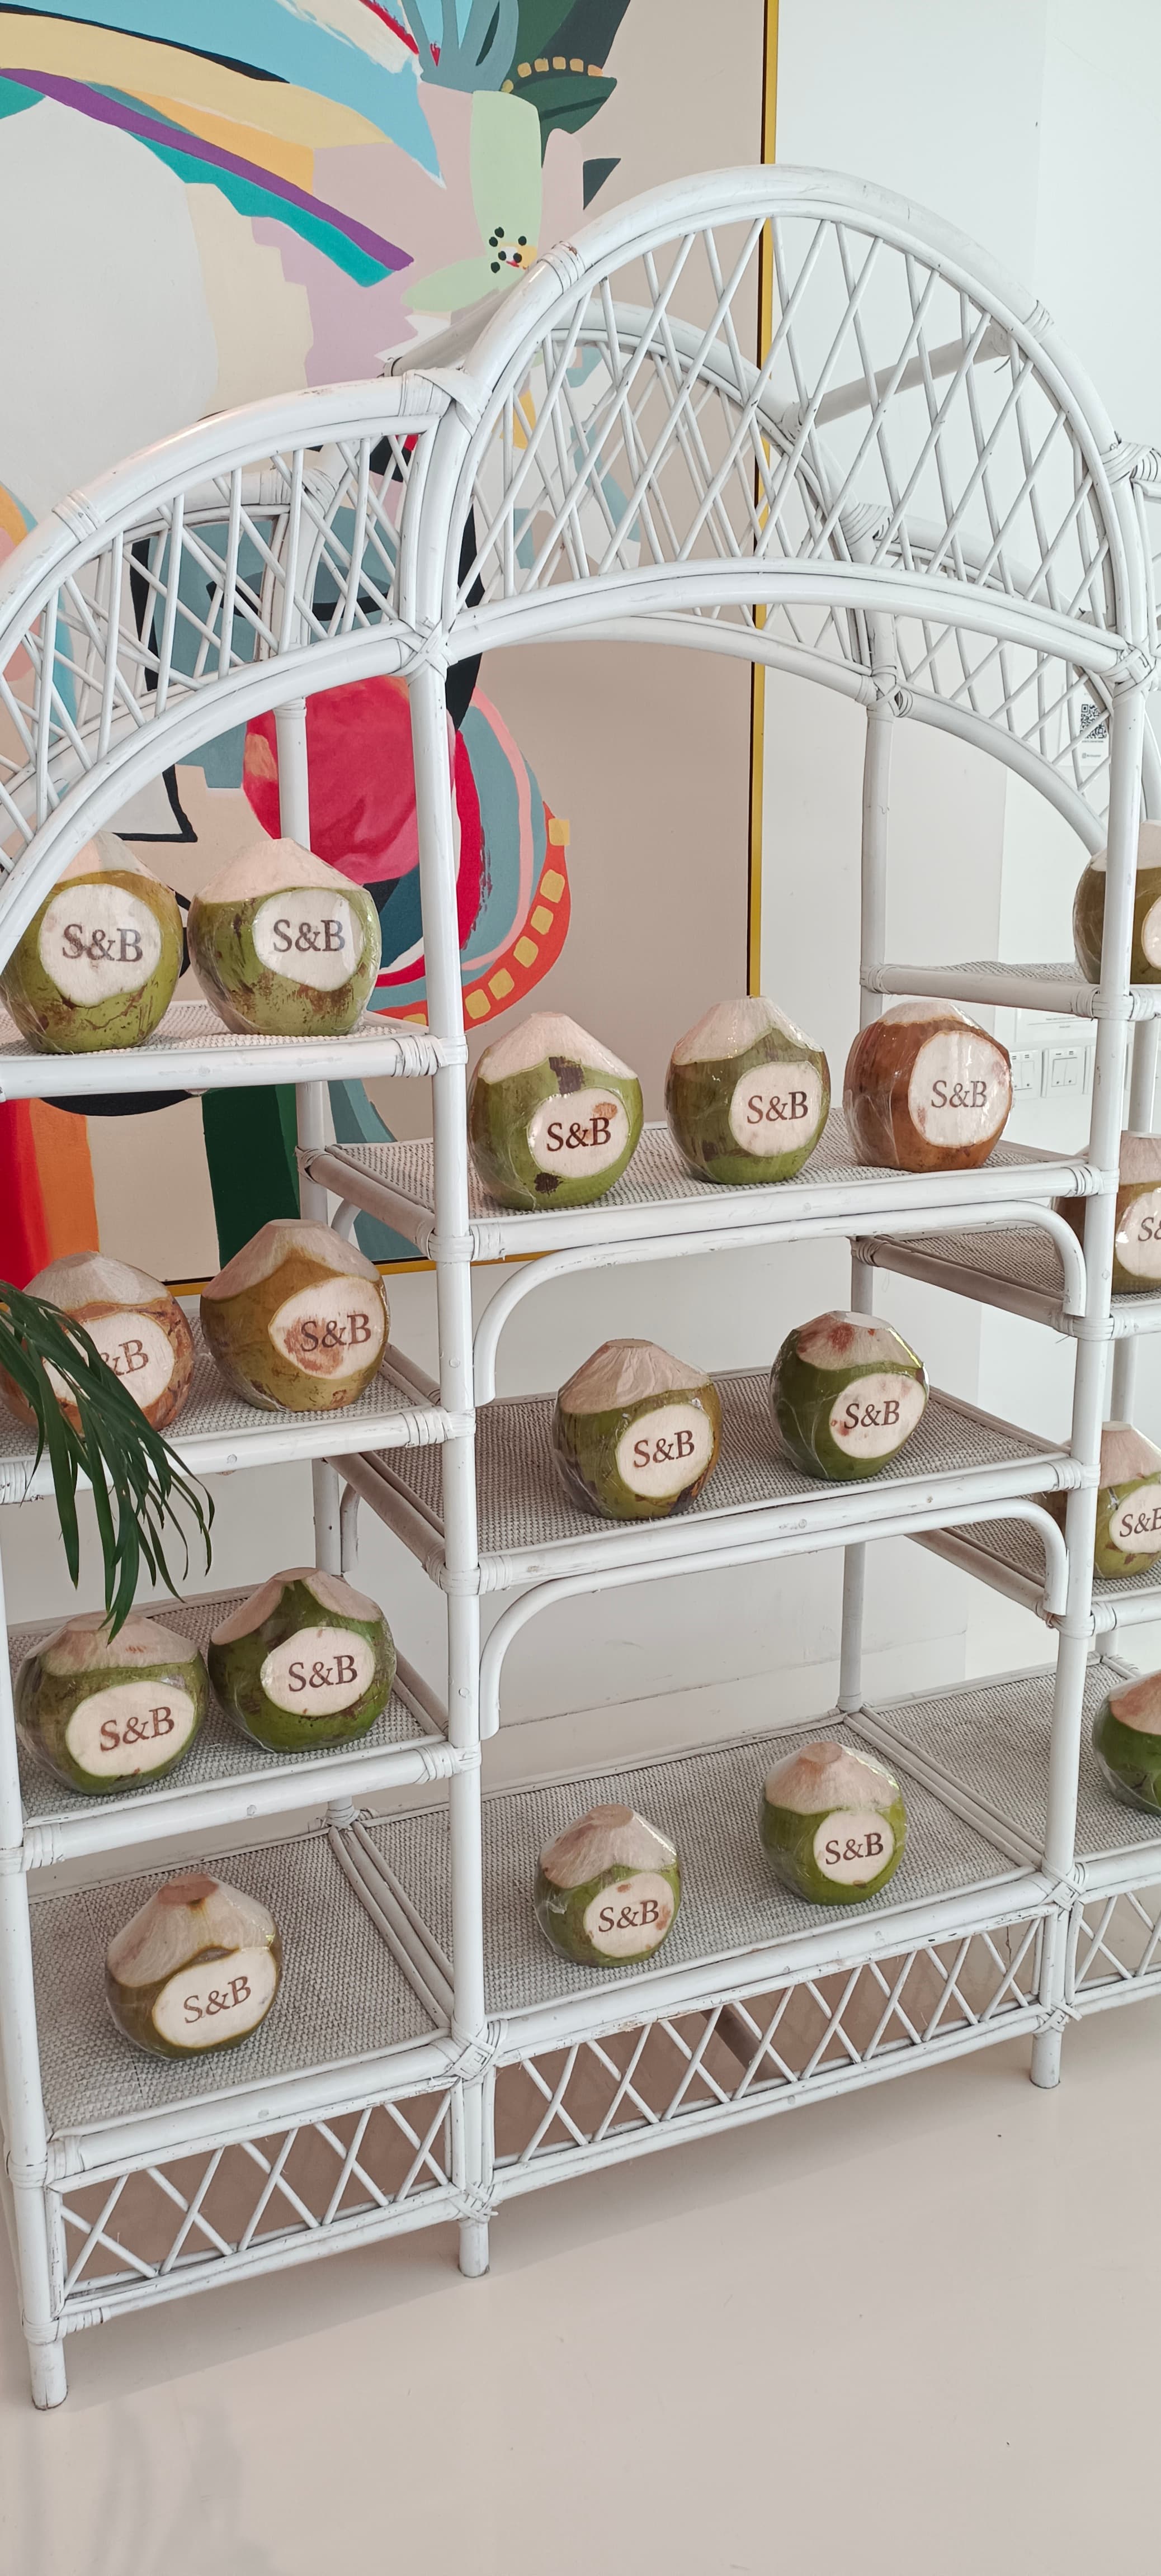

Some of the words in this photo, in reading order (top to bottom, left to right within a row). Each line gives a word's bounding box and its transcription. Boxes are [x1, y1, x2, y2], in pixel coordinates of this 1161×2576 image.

[62, 924, 143, 963] S&B
[273, 918, 345, 951] S&B
[747, 1091, 808, 1125] S&B
[929, 1079, 988, 1109] S&B
[546, 1116, 612, 1152] S&B
[300, 1314, 371, 1352] S&B
[101, 1339, 149, 1376] &B
[843, 1400, 900, 1429] S&B
[633, 1430, 695, 1467] S&B
[288, 1655, 358, 1692] S&B
[99, 1706, 175, 1751] S&B
[824, 1832, 884, 1865] S&B
[598, 1899, 659, 1933] S&B
[183, 1976, 251, 2024] S&B
